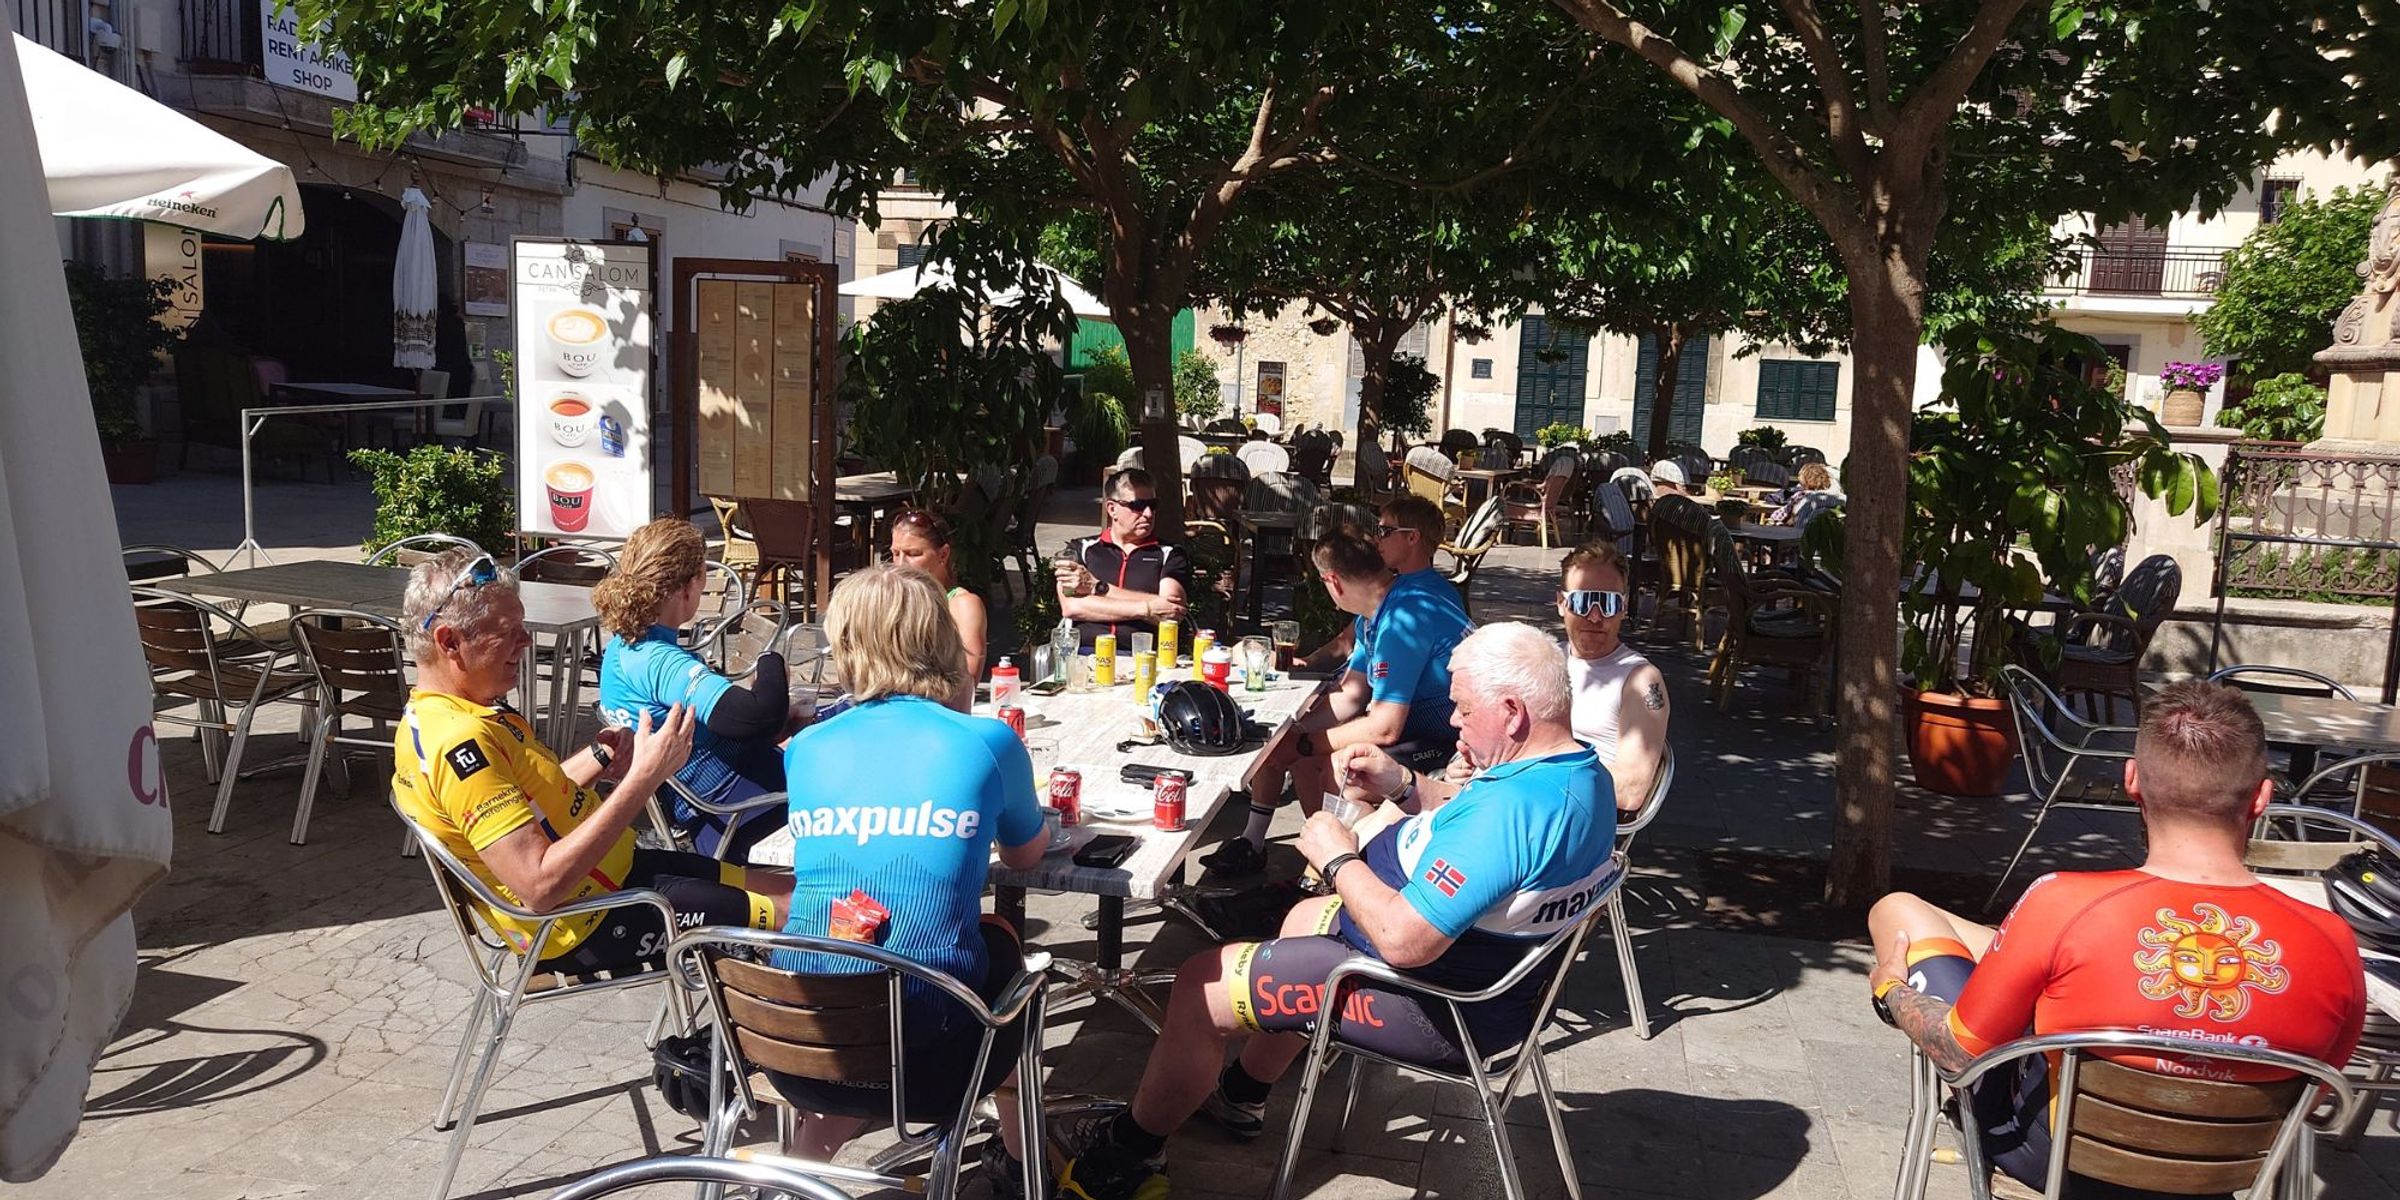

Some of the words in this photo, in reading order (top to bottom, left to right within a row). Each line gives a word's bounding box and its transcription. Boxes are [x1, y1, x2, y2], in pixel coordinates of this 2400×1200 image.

[268, 39, 307, 62] RENT
[309, 51, 321, 66] A
[323, 57, 353, 75] BIKE
[293, 69, 333, 91] SHOP
[147, 199, 217, 219] Heineken
[528, 262, 567, 280] CAN
[573, 264, 639, 283] SALOM
[563, 352, 596, 363] BOU
[554, 421, 585, 434] BOU
[552, 493, 581, 506] BOU
[788, 799, 981, 847] maxpulse
[2155, 1057, 2237, 1081] Nordvik
